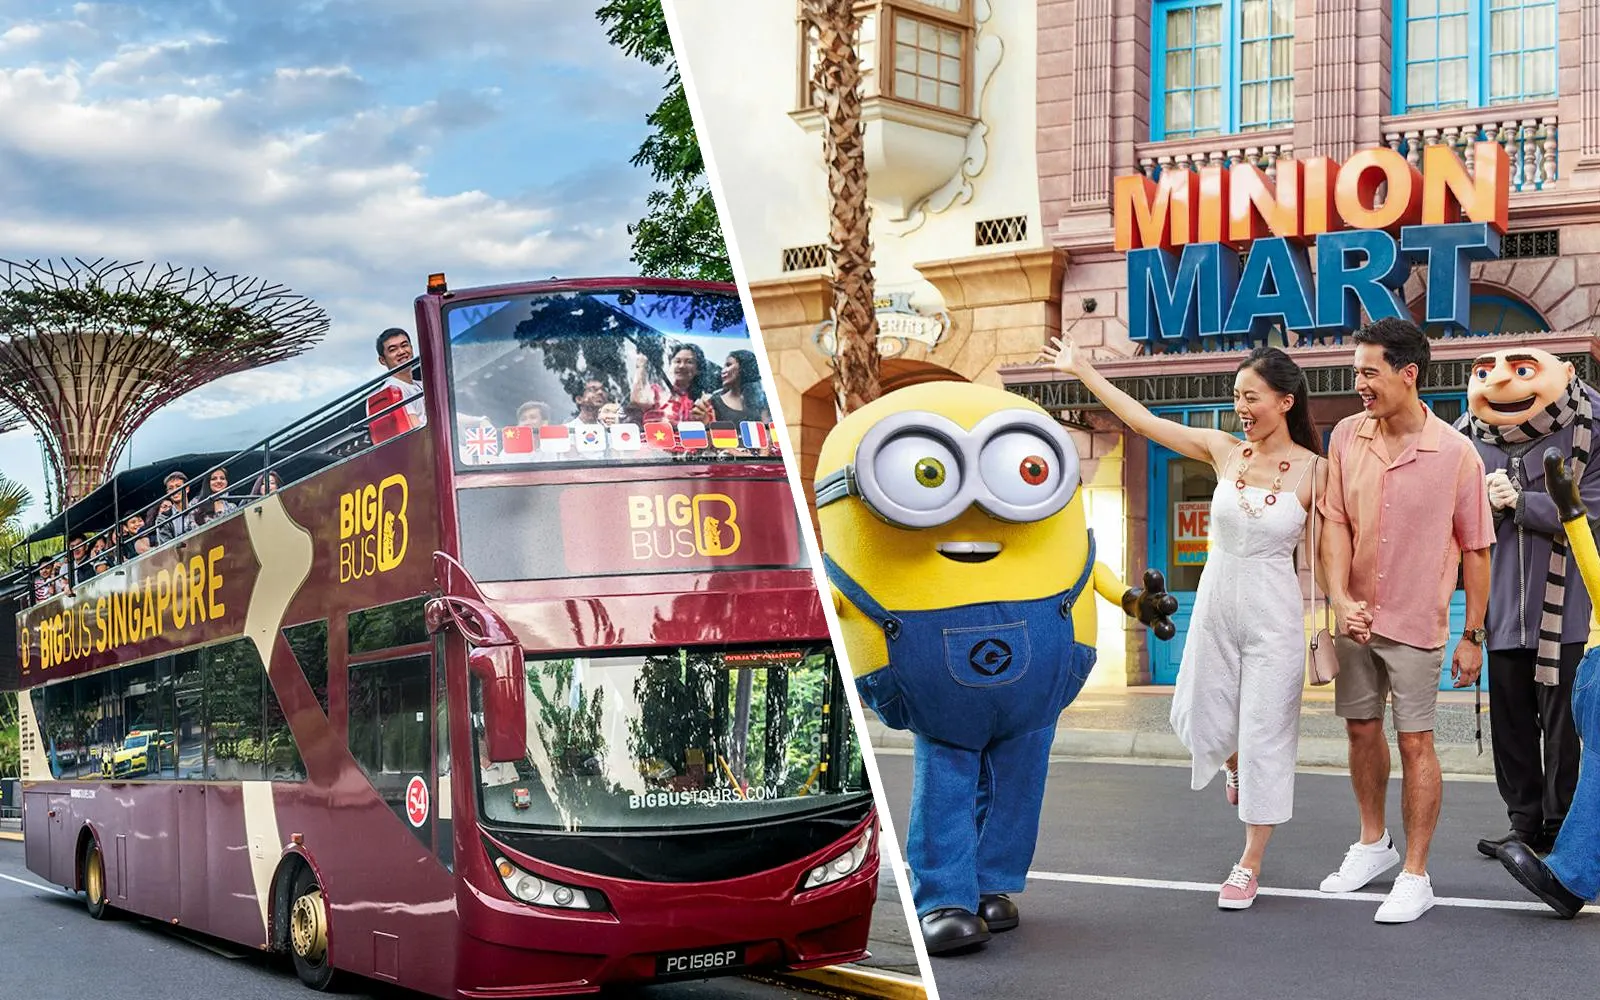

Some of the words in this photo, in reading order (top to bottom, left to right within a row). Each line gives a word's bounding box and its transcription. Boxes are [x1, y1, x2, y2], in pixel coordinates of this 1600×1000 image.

[1114, 141, 1508, 251] MINION
[1126, 221, 1500, 340] MART
[340, 483, 377, 540] BIG
[628, 493, 693, 529] BIG
[1178, 511, 1210, 536] ME
[340, 533, 377, 584] BUS
[631, 528, 696, 560] BUS
[95, 544, 226, 654] SINGAPORE
[409, 787, 426, 815] 54
[628, 784, 779, 809] BIGBUSTOURS.COM
[666, 950, 736, 972] PC1586P
